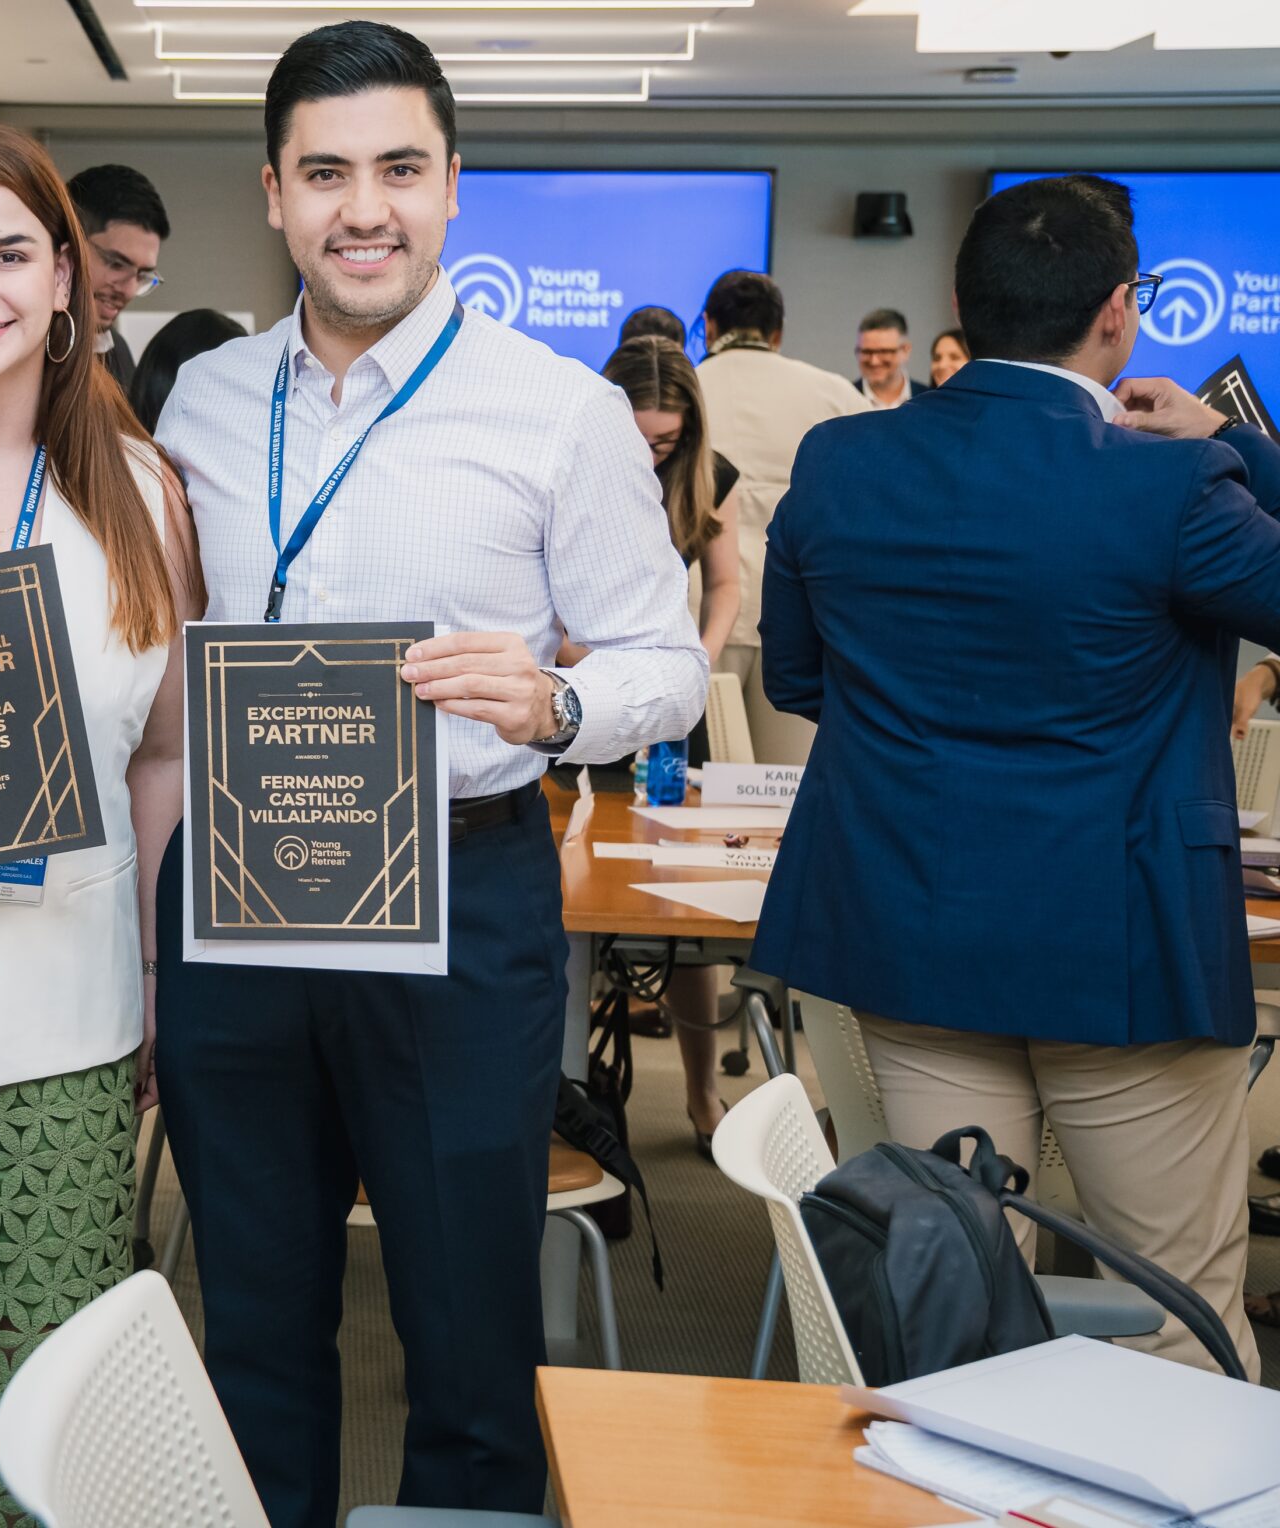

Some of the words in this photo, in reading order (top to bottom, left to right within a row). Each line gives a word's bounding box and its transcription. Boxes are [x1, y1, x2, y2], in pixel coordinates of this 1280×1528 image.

[527, 265, 600, 291] Young
[1233, 270, 1280, 292] You
[527, 287, 623, 307] Partners
[527, 307, 609, 328] Retreat
[274, 400, 283, 433] RETREAT
[272, 433, 280, 472] PARTNERS
[25, 488, 38, 513] YOUNG
[33, 450, 47, 488] PARTNERS
[315, 479, 336, 505] YOUNG
[332, 443, 360, 480] PARTNERS
[271, 472, 279, 499] YOUNG
[247, 706, 376, 720] EXCEPTIONAL
[248, 723, 376, 745] PARTNER
[261, 775, 365, 789] FERNANDO
[269, 792, 357, 806] CASTILLO
[249, 809, 378, 824] VILLALPANDO
[310, 840, 341, 850] Young
[311, 849, 352, 857] Partners
[311, 857, 346, 866] Retreat
